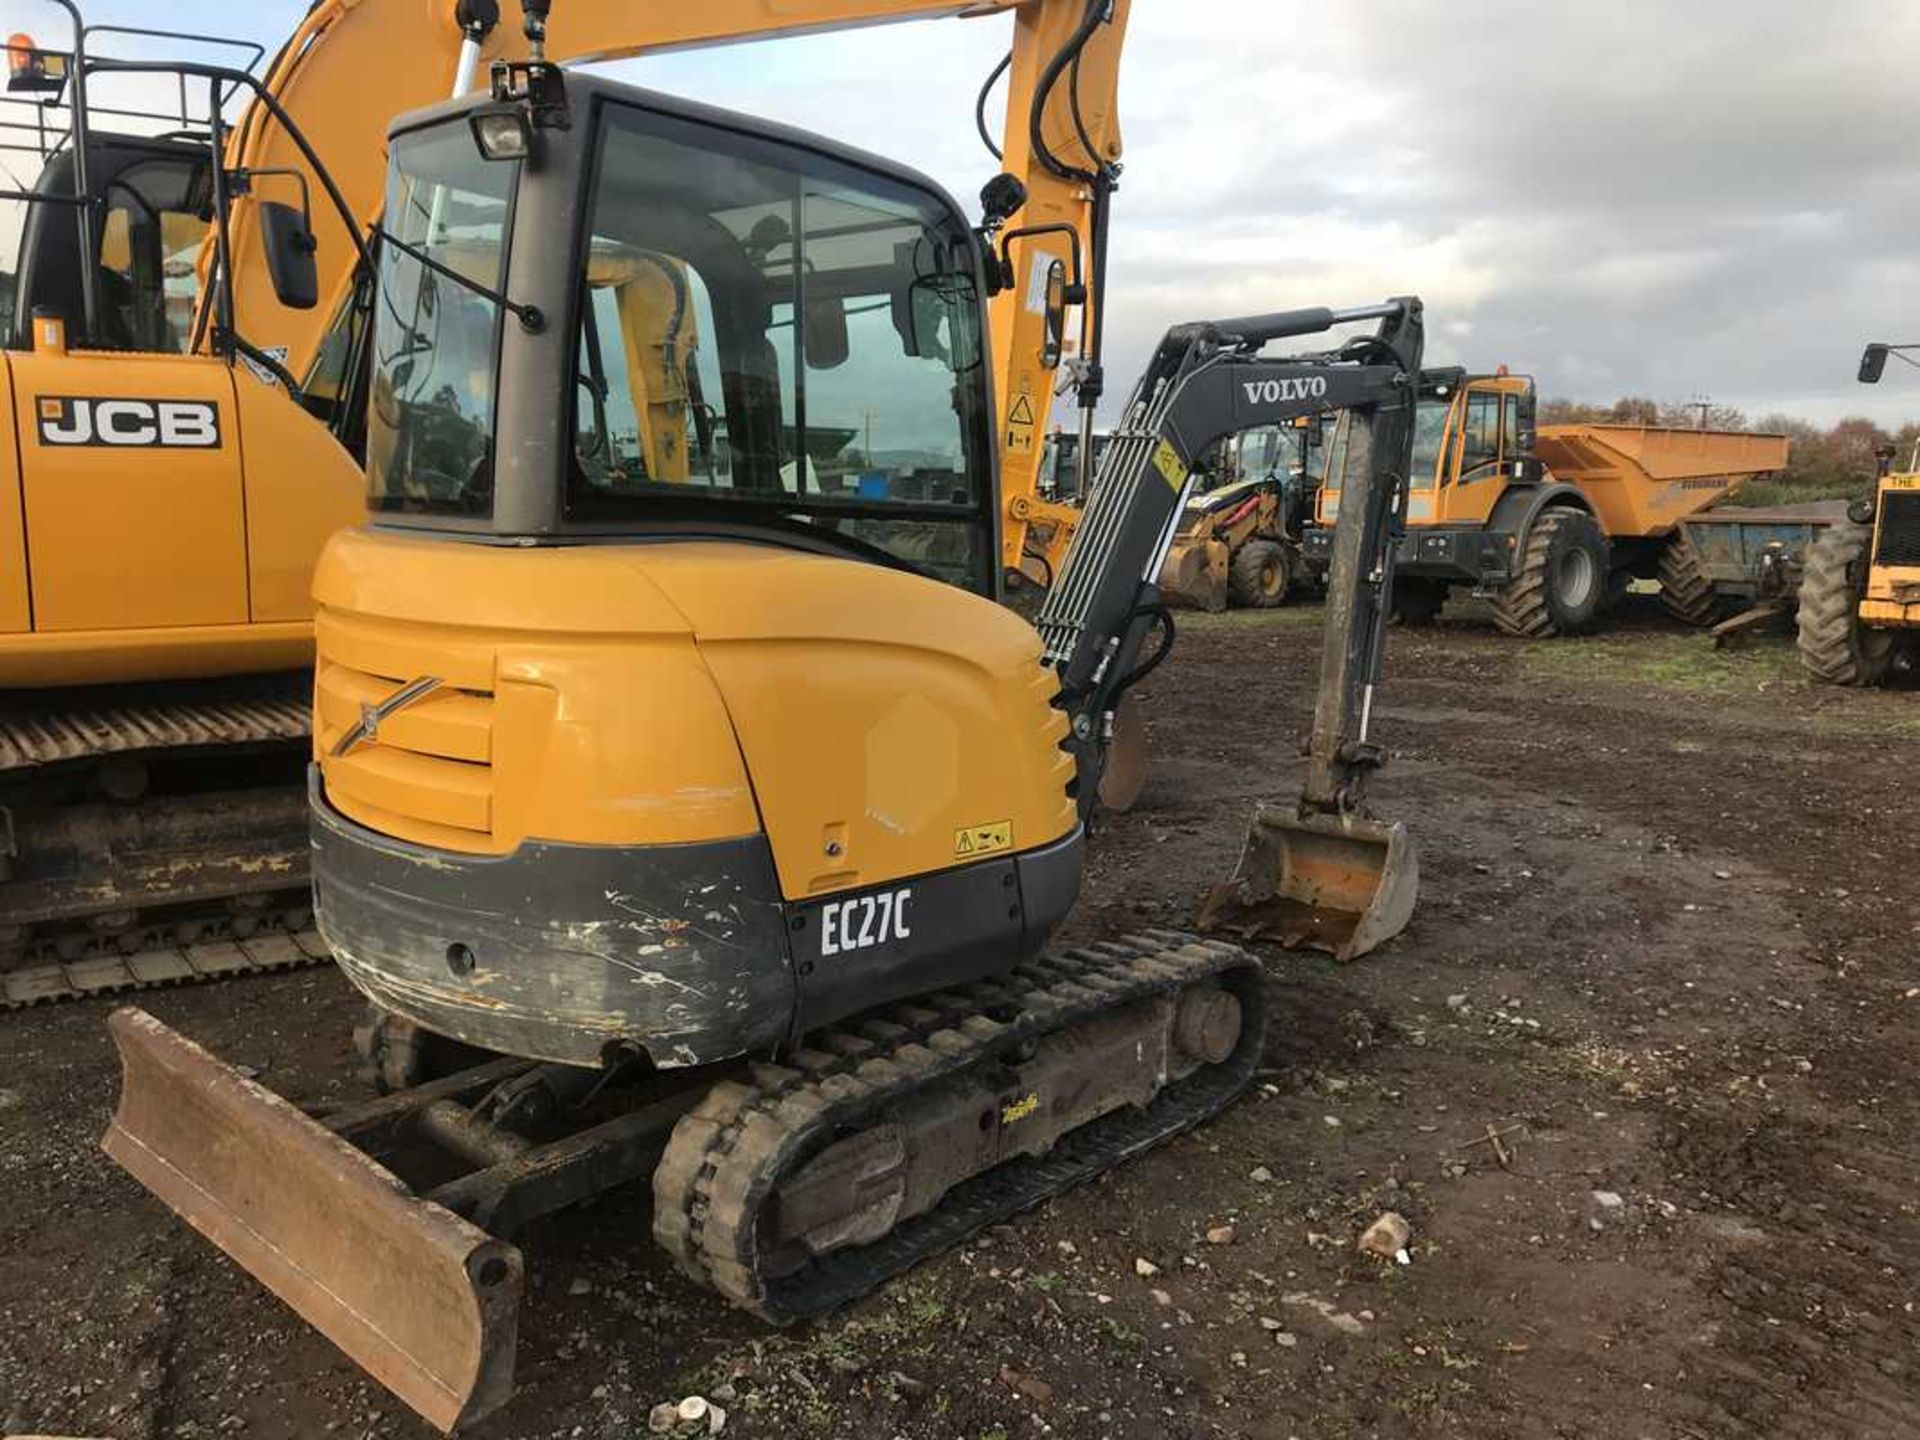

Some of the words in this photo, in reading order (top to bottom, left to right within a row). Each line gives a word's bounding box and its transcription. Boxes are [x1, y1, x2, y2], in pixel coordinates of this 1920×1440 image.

[1242, 375, 1327, 405] VOLVO
[42, 399, 217, 446] JCB
[821, 888, 912, 956] EC27C
